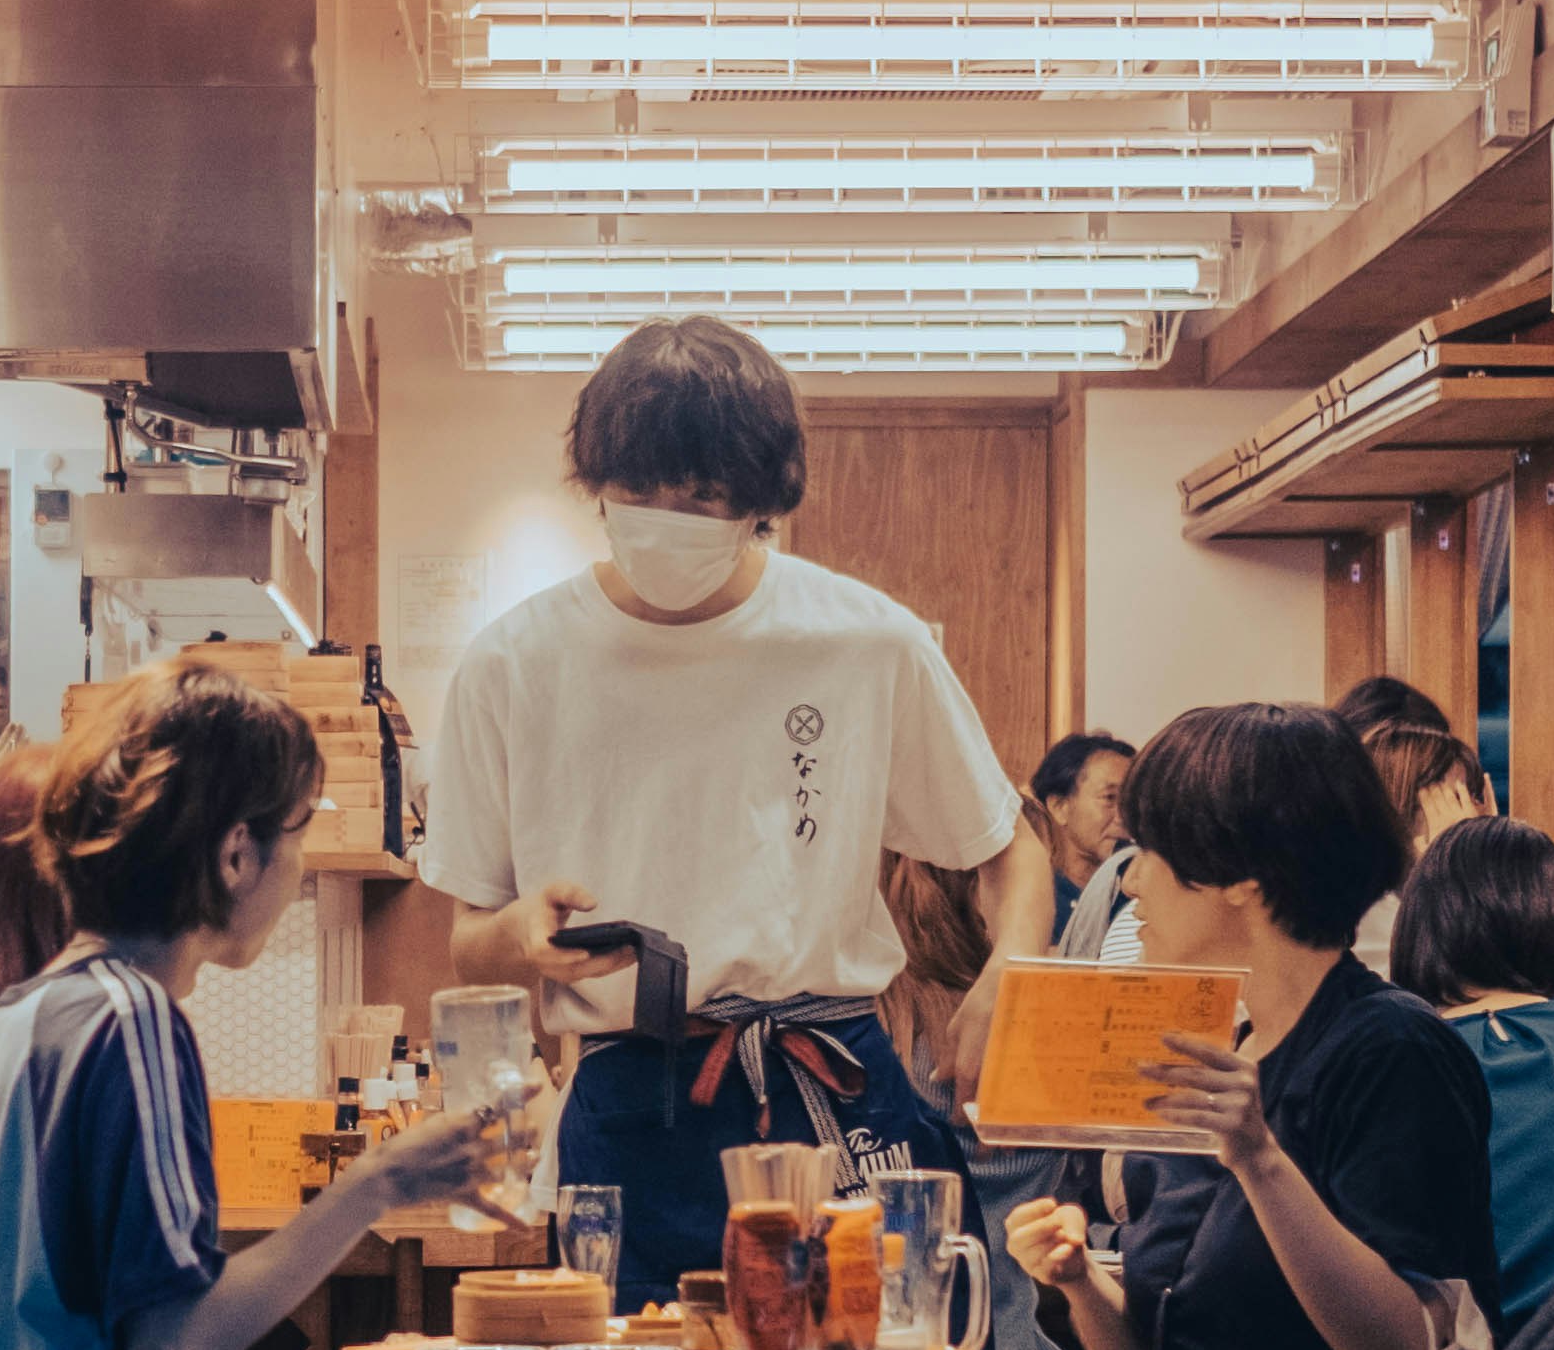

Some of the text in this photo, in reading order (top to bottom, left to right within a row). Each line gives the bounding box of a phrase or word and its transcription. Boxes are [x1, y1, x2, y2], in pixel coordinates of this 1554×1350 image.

[792, 750, 821, 845] なかめ
[846, 1127, 882, 1153] The
